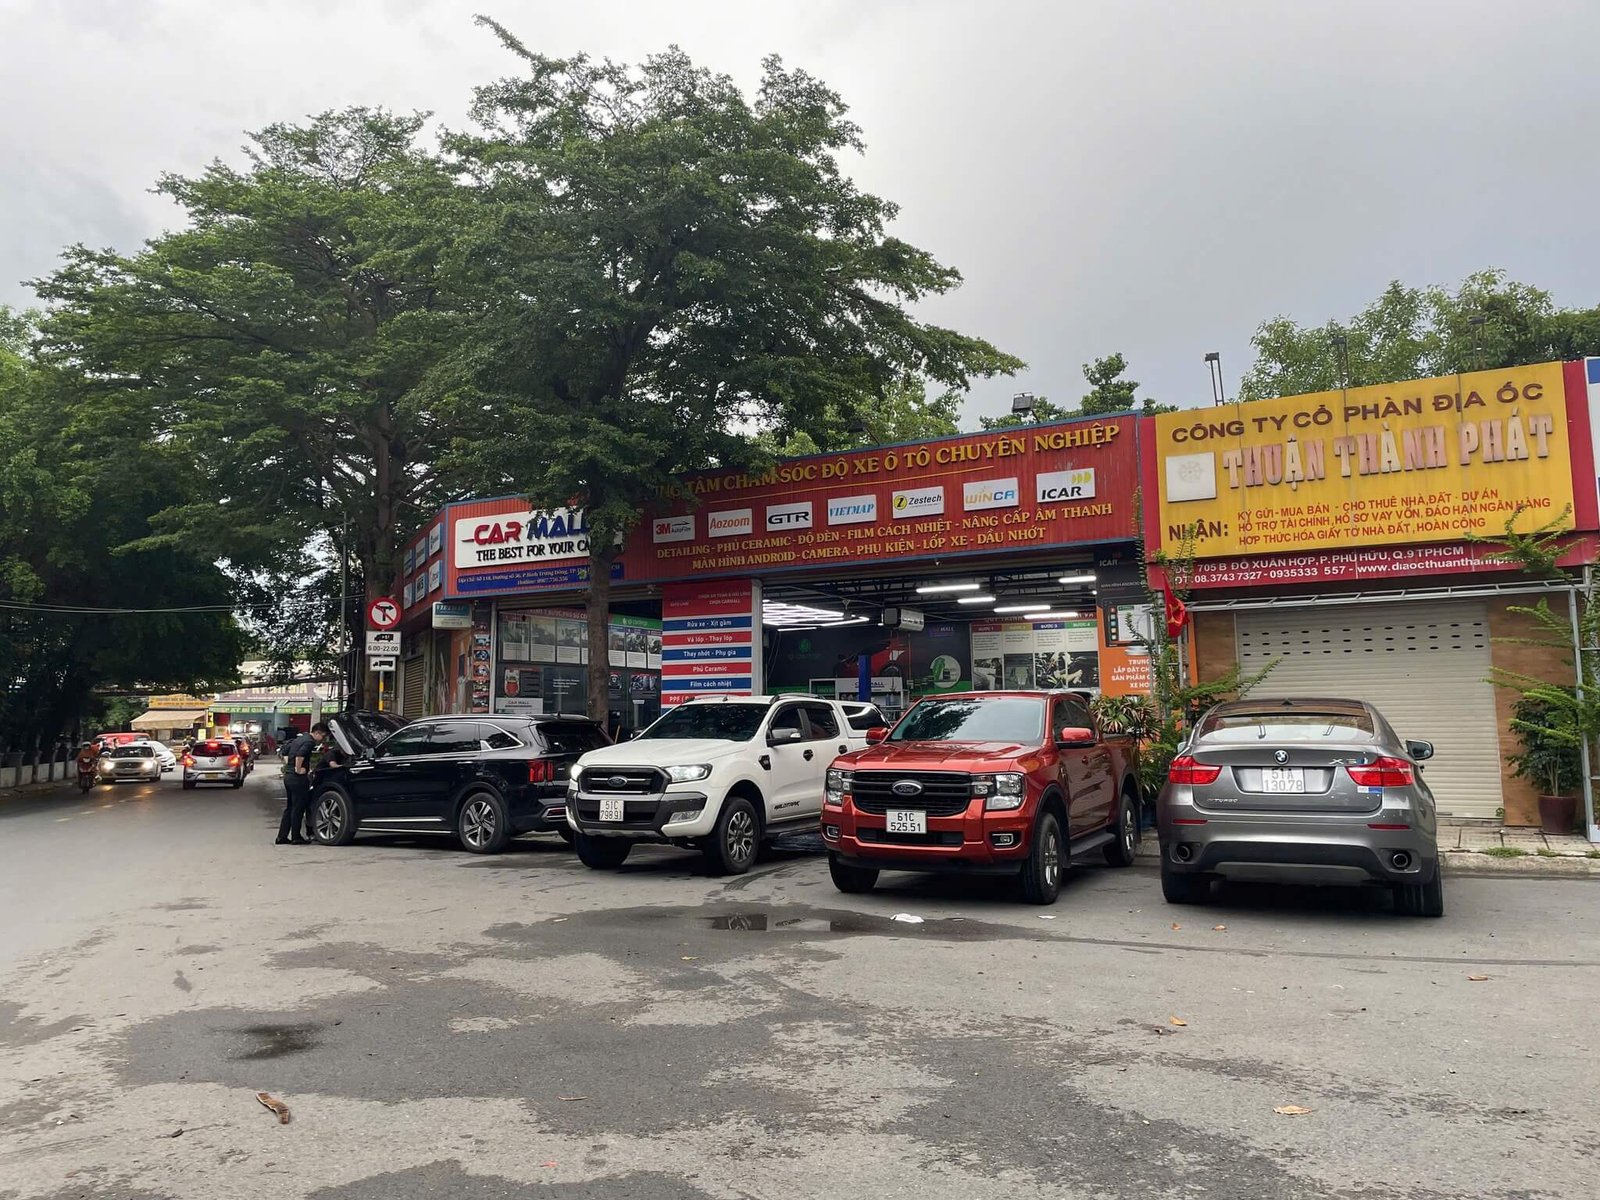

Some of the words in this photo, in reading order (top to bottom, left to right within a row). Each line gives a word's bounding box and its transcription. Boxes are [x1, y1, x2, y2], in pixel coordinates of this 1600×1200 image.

[1172, 420, 1245, 443] CÔNG
[1252, 415, 1288, 433] TY
[1496, 381, 1544, 404] ỐC
[1223, 434, 1325, 491] THUẬN
[1333, 421, 1447, 478] THÀNH
[1458, 406, 1553, 466] PHÁT
[685, 475, 720, 494] TÂM
[780, 463, 817, 483] SÓC
[821, 458, 849, 480] ĐỘ
[853, 457, 879, 475] XE
[884, 451, 898, 471] Ô
[904, 446, 931, 468] TÔ
[936, 436, 1026, 464] CHUYÊN
[1035, 422, 1120, 451] NGHIỆP
[908, 494, 942, 506] Zestech
[1041, 486, 1082, 500] ICAR
[829, 504, 875, 518] VIETMAP
[1237, 509, 1252, 522] KÝ
[1281, 506, 1303, 518] MUA
[1307, 502, 1329, 515] BÁN
[1343, 500, 1365, 512] CHO
[1368, 496, 1397, 510] THUÊ
[1462, 491, 1479, 503] DỰ
[1481, 488, 1498, 501] ÁN
[1256, 520, 1278, 531] TRỢ
[1280, 517, 1297, 529] TÀI
[1354, 513, 1369, 523] SƠ
[1371, 511, 1393, 523] VAY
[1426, 504, 1450, 517] ĐÁO
[1453, 501, 1477, 516] HẠN
[1480, 499, 1513, 513] NGÂN
[1515, 496, 1550, 511] HÀNG
[710, 516, 750, 530] Aozoom
[768, 511, 809, 525] GTR
[473, 521, 522, 545] CAR
[656, 522, 670, 535] 3M
[657, 544, 710, 558] DETAILING
[717, 538, 740, 552] PHỦ
[741, 536, 791, 551] CERAMIC
[798, 532, 814, 547] ĐỘ
[817, 530, 839, 543] ĐÈN
[847, 527, 874, 540] FILM
[877, 523, 911, 537] CÁCH
[915, 518, 952, 533] NHIỆT
[962, 515, 999, 529] NÂNG
[1003, 508, 1030, 524] CẤP
[1035, 508, 1056, 522] ÂM
[1062, 503, 1113, 519] THANH
[1263, 531, 1291, 544] THỨC
[1293, 529, 1315, 542] HÓA
[1317, 525, 1341, 539] GIẤY
[1362, 523, 1385, 536] NHÀ
[1452, 517, 1486, 530] CÔNG
[476, 549, 496, 562] THE
[498, 546, 524, 560] BEST
[526, 544, 546, 557] FOR
[548, 541, 575, 555] YOUR
[692, 556, 716, 569] MÀN
[718, 554, 745, 568] HÌNH
[749, 551, 795, 565] ANDROID
[802, 546, 850, 560] CAMERA
[857, 544, 881, 557] PHỤ
[886, 539, 914, 554] KIỆN
[923, 535, 945, 549] LỐP
[951, 535, 968, 547] XE
[977, 528, 1004, 545] DẦU
[1008, 525, 1046, 541] NHỚT
[1197, 563, 1217, 573] 705
[1219, 562, 1227, 571] B
[1252, 556, 1286, 570] XUÂN
[1418, 546, 1464, 558] TPHCM
[1270, 567, 1318, 578] 0935333
[1324, 566, 1346, 575] 557
[1272, 767, 1293, 779] 51A
[1264, 780, 1303, 792] 130.78
[605, 801, 618, 809] 51C
[891, 822, 921, 832] 525.51
